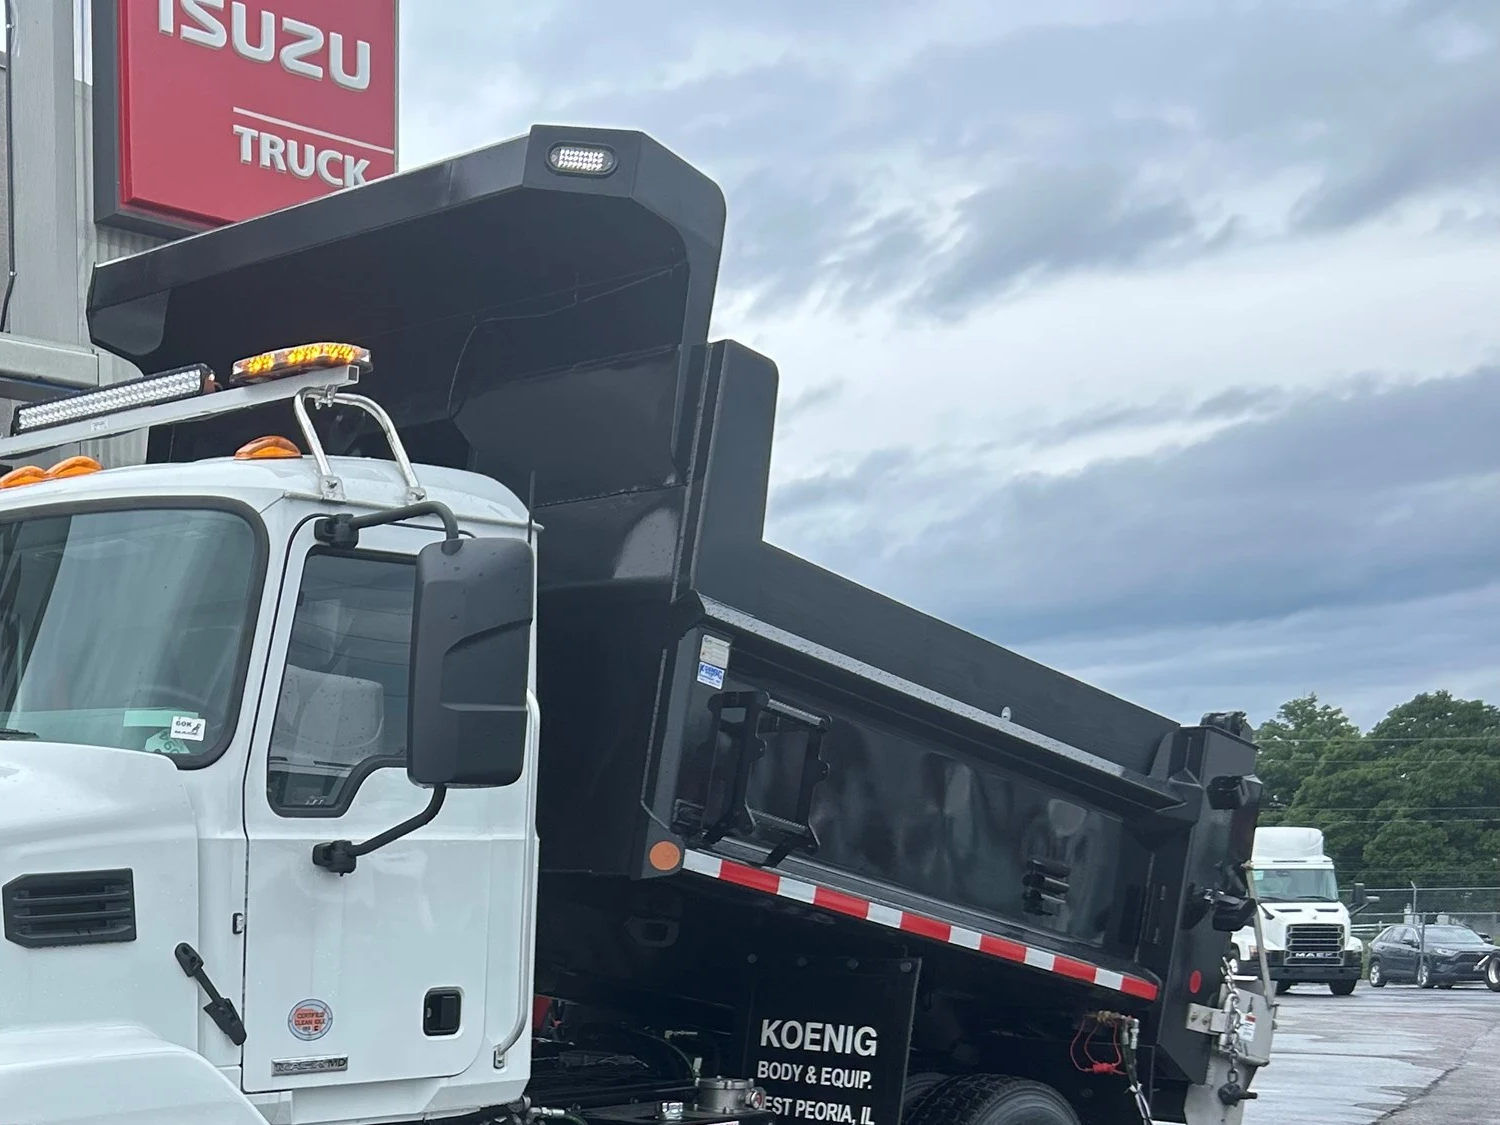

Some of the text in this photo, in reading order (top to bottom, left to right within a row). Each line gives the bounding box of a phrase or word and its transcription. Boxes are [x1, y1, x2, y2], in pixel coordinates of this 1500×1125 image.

[158, 0, 370, 91] ISUZU
[233, 124, 370, 188] TRUCK
[760, 1019, 878, 1057] KOENIG
[275, 1058, 346, 1072] MACK MD
[757, 1060, 873, 1090] BODY & EQUIP.
[763, 1095, 793, 1116] EST
[860, 1106, 876, 1125] IL
